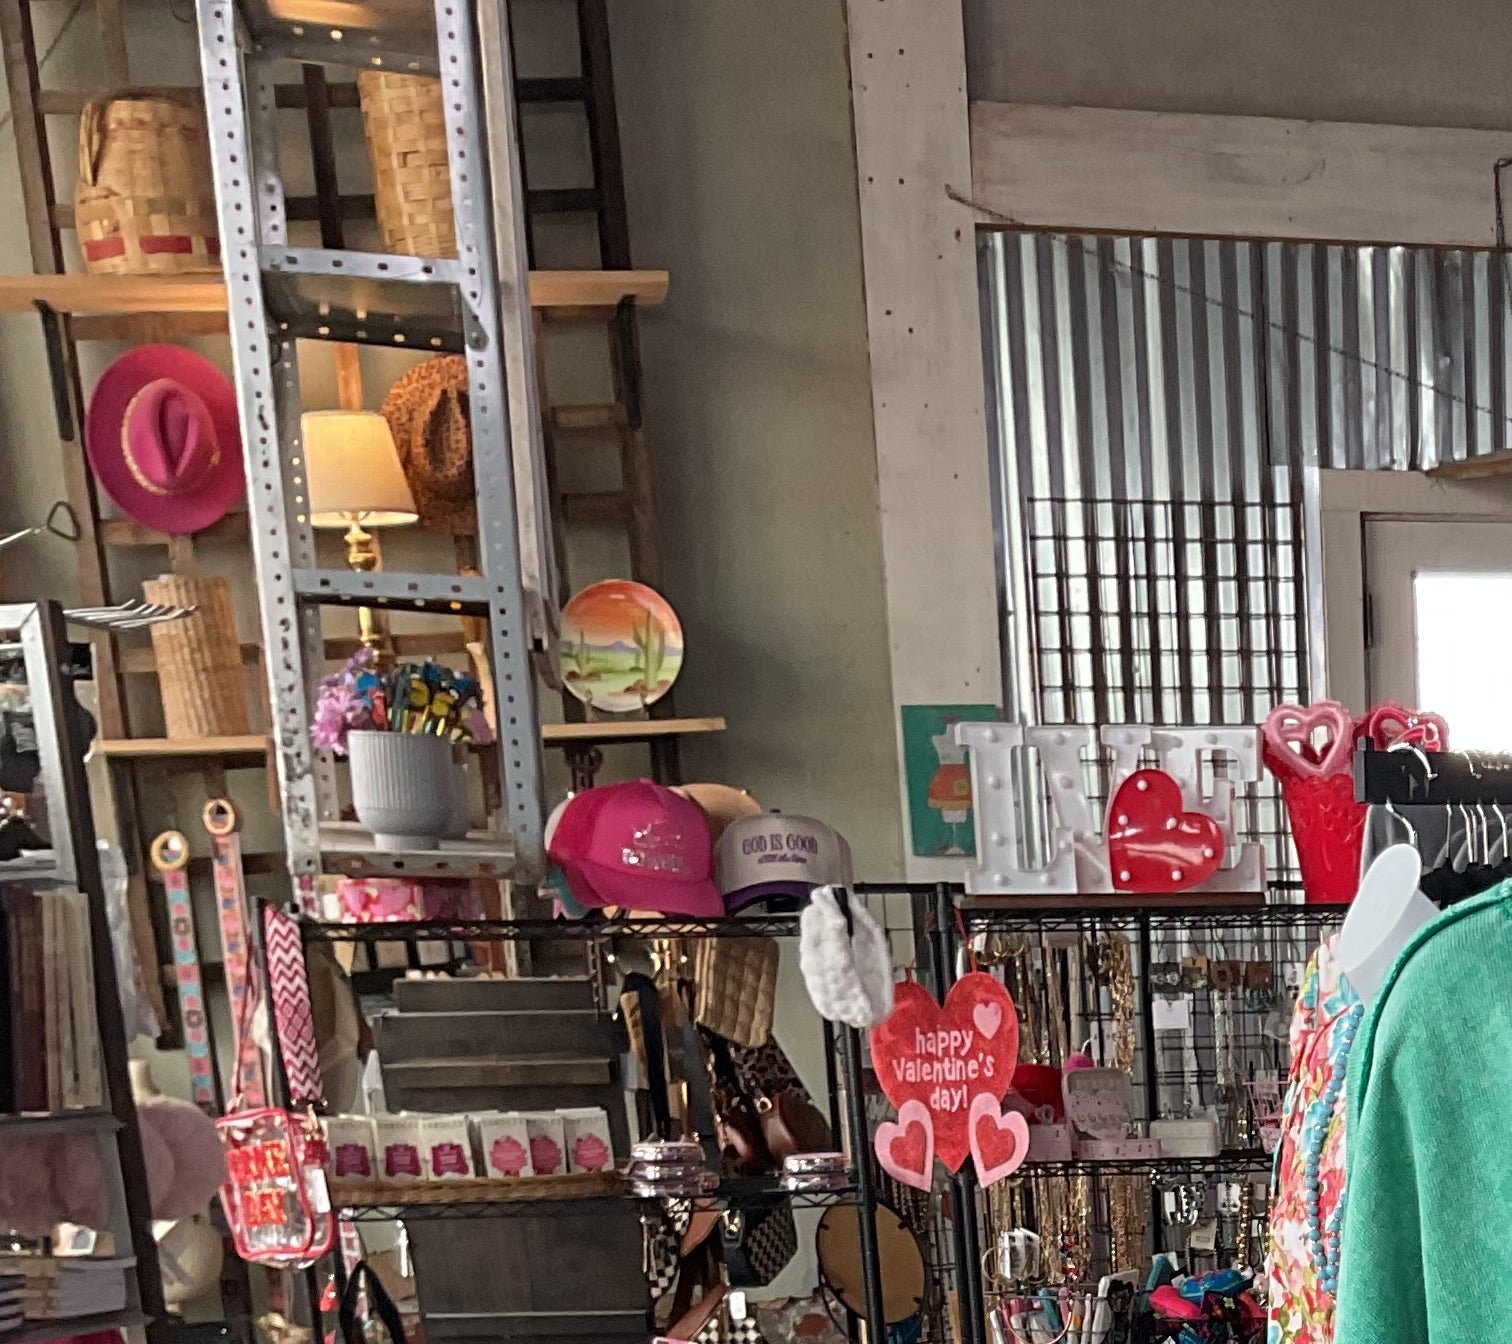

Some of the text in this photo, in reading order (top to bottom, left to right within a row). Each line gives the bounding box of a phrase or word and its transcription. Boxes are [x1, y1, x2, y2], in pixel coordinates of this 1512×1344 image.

[742, 833, 818, 855] GOD IS GOOD
[915, 1026, 974, 1057] happy
[892, 1052, 996, 1083] Valentine's
[929, 1084, 968, 1113] day!
